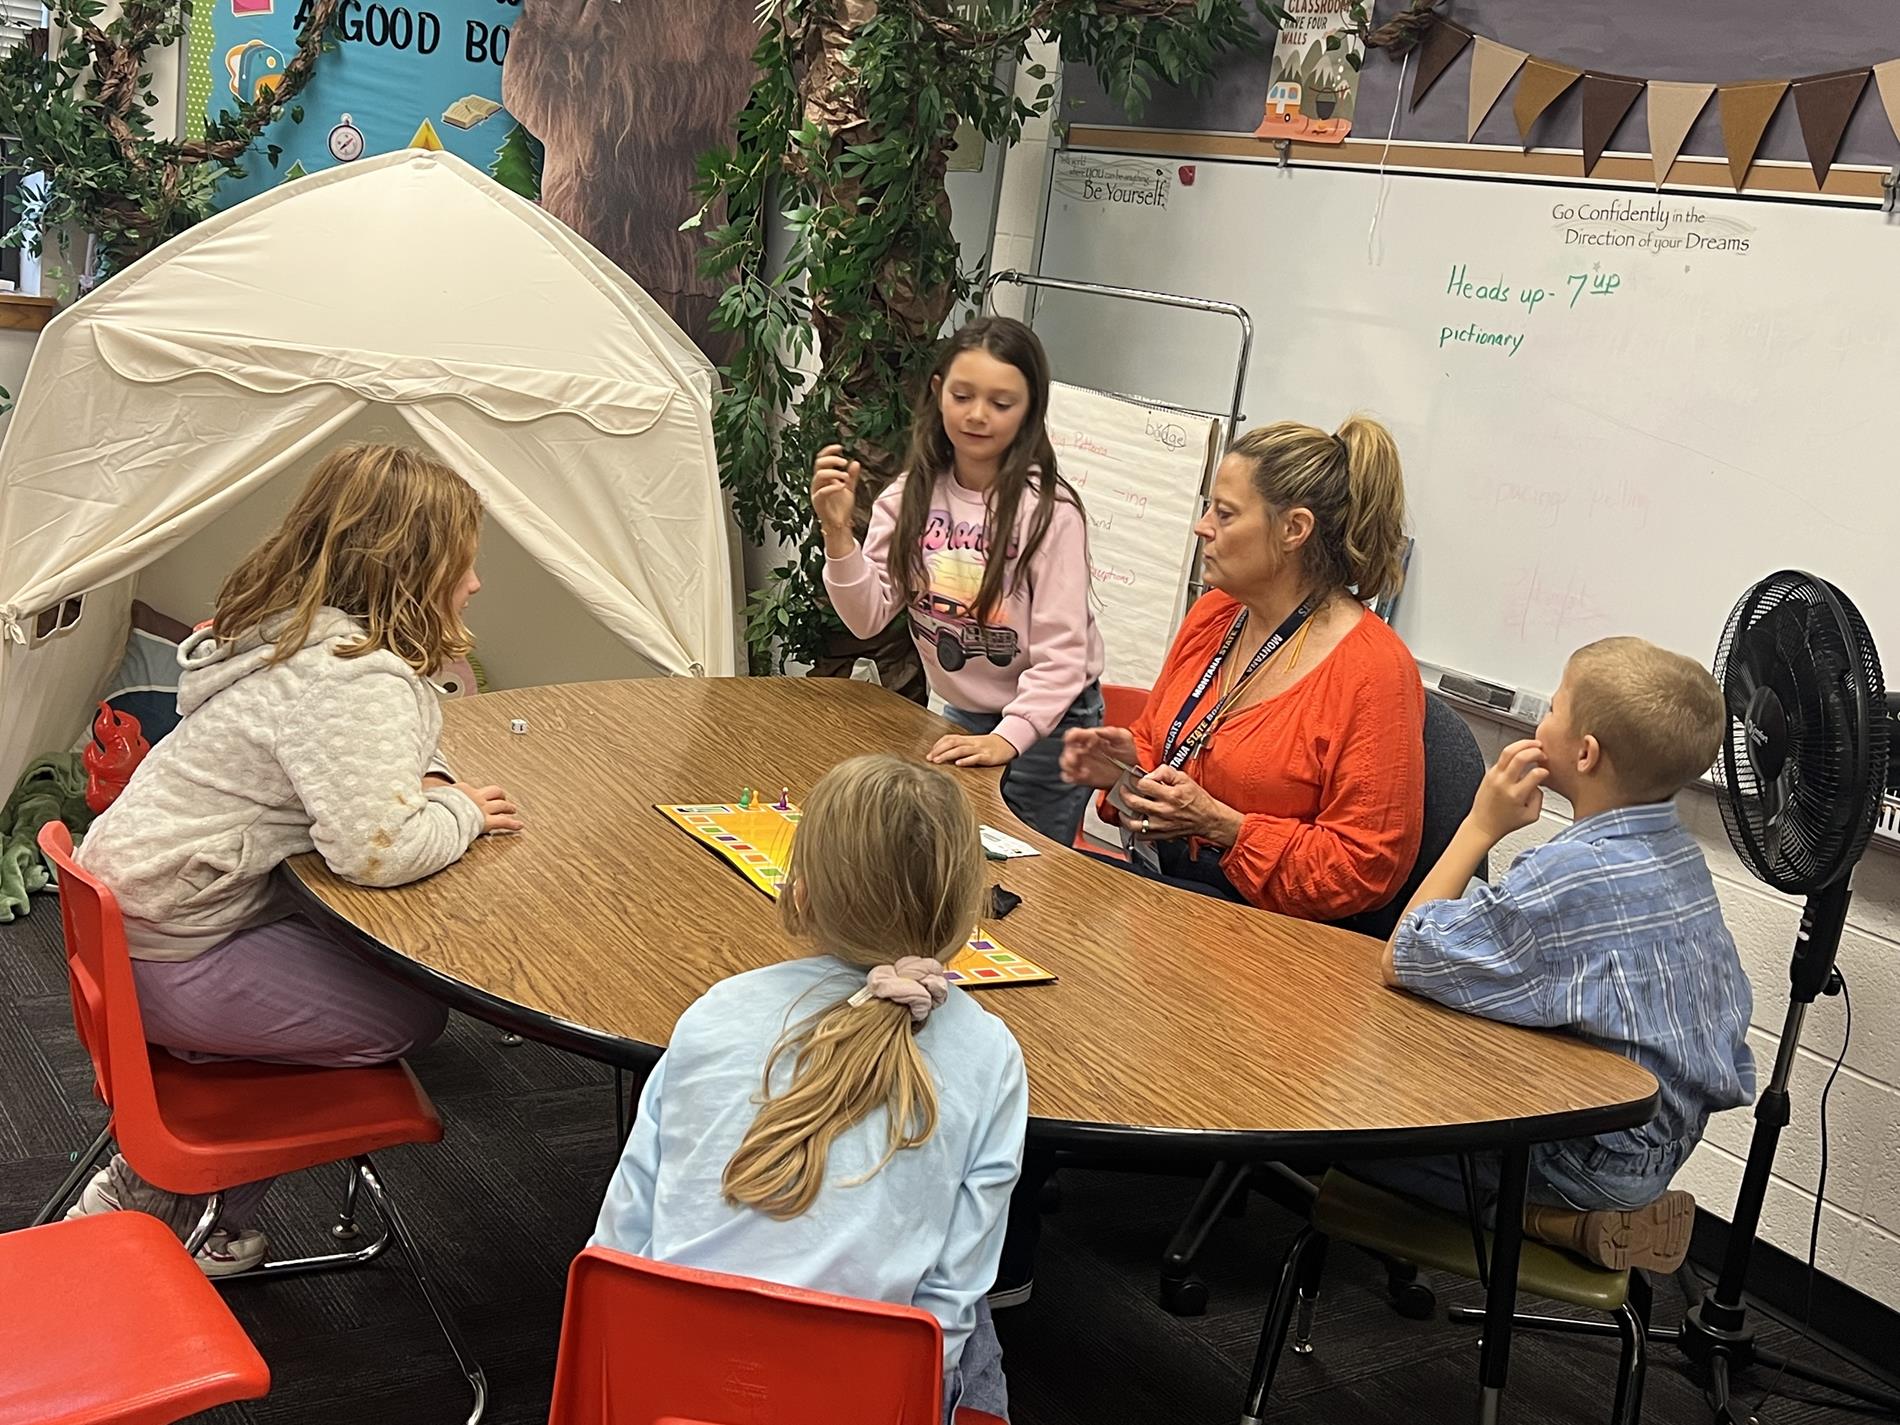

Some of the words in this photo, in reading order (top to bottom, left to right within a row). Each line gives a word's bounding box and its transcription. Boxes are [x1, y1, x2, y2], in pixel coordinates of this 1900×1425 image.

[1288, 0, 1351, 14] CLASSROOM
[338, 0, 441, 55] GOOD
[465, 19, 511, 66] BO
[1307, 16, 1328, 29] FOUR
[1282, 33, 1307, 45] WALLS
[1082, 180, 1103, 200] Be
[1106, 179, 1167, 207] Yourself.
[1552, 203, 1574, 220] Go
[1578, 199, 1670, 231] Confidently
[1672, 208, 1683, 222] in
[1685, 206, 1706, 223] the
[1565, 228, 1635, 247] Direction
[1638, 231, 1655, 247] of
[1652, 239, 1683, 254] your
[1685, 232, 1750, 251] Dreams
[1447, 264, 1511, 302] Heads
[1567, 273, 1589, 309] 7
[1591, 273, 1621, 296] up
[1439, 323, 1525, 358] pictionary
[1191, 655, 1222, 699] MONTANA
[1219, 630, 1238, 657] STATE
[1246, 633, 1283, 675] MONTANA
[1186, 721, 1208, 747] STATE
